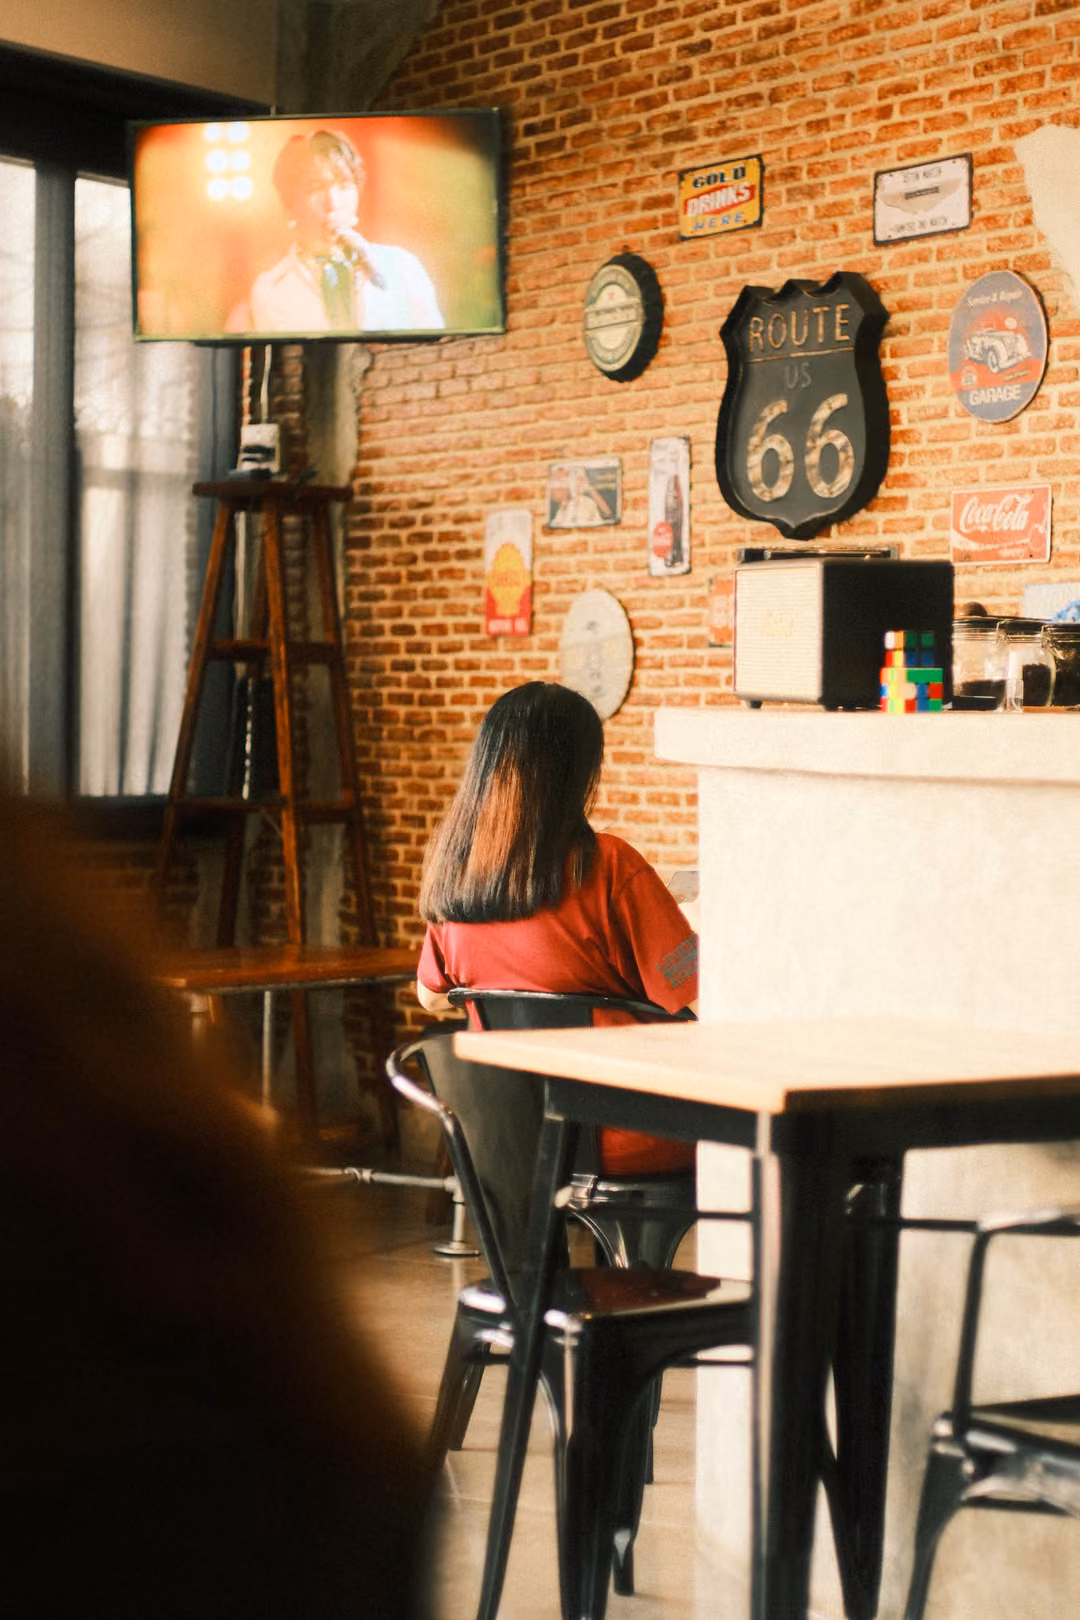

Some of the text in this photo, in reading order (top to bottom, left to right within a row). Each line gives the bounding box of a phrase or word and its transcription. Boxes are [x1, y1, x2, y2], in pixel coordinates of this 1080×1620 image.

[687, 182, 750, 216] DRINKS
[692, 212, 744, 230] HERE
[749, 303, 851, 353] ROUTE
[784, 362, 812, 389] US
[969, 384, 1022, 406] GARAGE
[746, 392, 855, 502] 66
